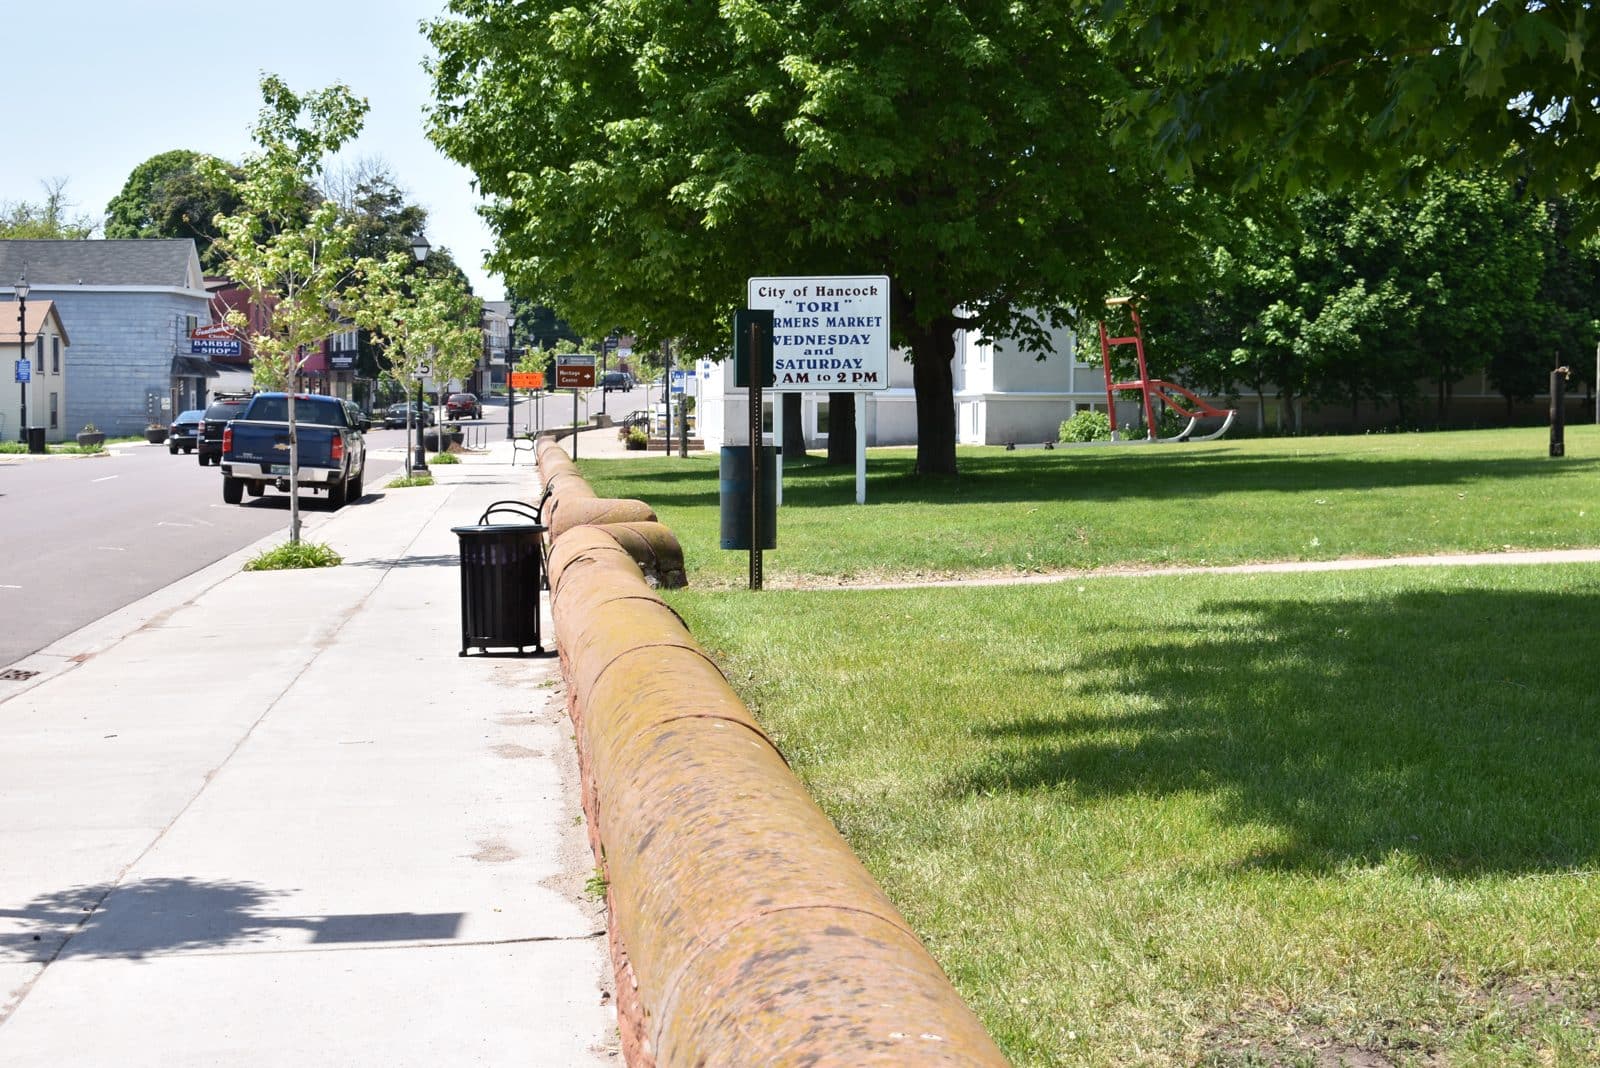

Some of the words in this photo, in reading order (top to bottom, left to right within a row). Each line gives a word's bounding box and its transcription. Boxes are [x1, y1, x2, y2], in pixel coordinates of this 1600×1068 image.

[758, 287, 786, 299] City
[793, 286, 808, 297] of
[816, 285, 878, 297] Hancock
[773, 316, 819, 328] RMERS
[826, 316, 882, 328] MARKET
[194, 340, 238, 348] BARBER
[803, 347, 834, 356] and
[775, 358, 863, 370] SATURDAY
[782, 372, 810, 384] AM
[817, 372, 831, 382] to
[837, 372, 847, 383] 2
[852, 371, 878, 383] PM
